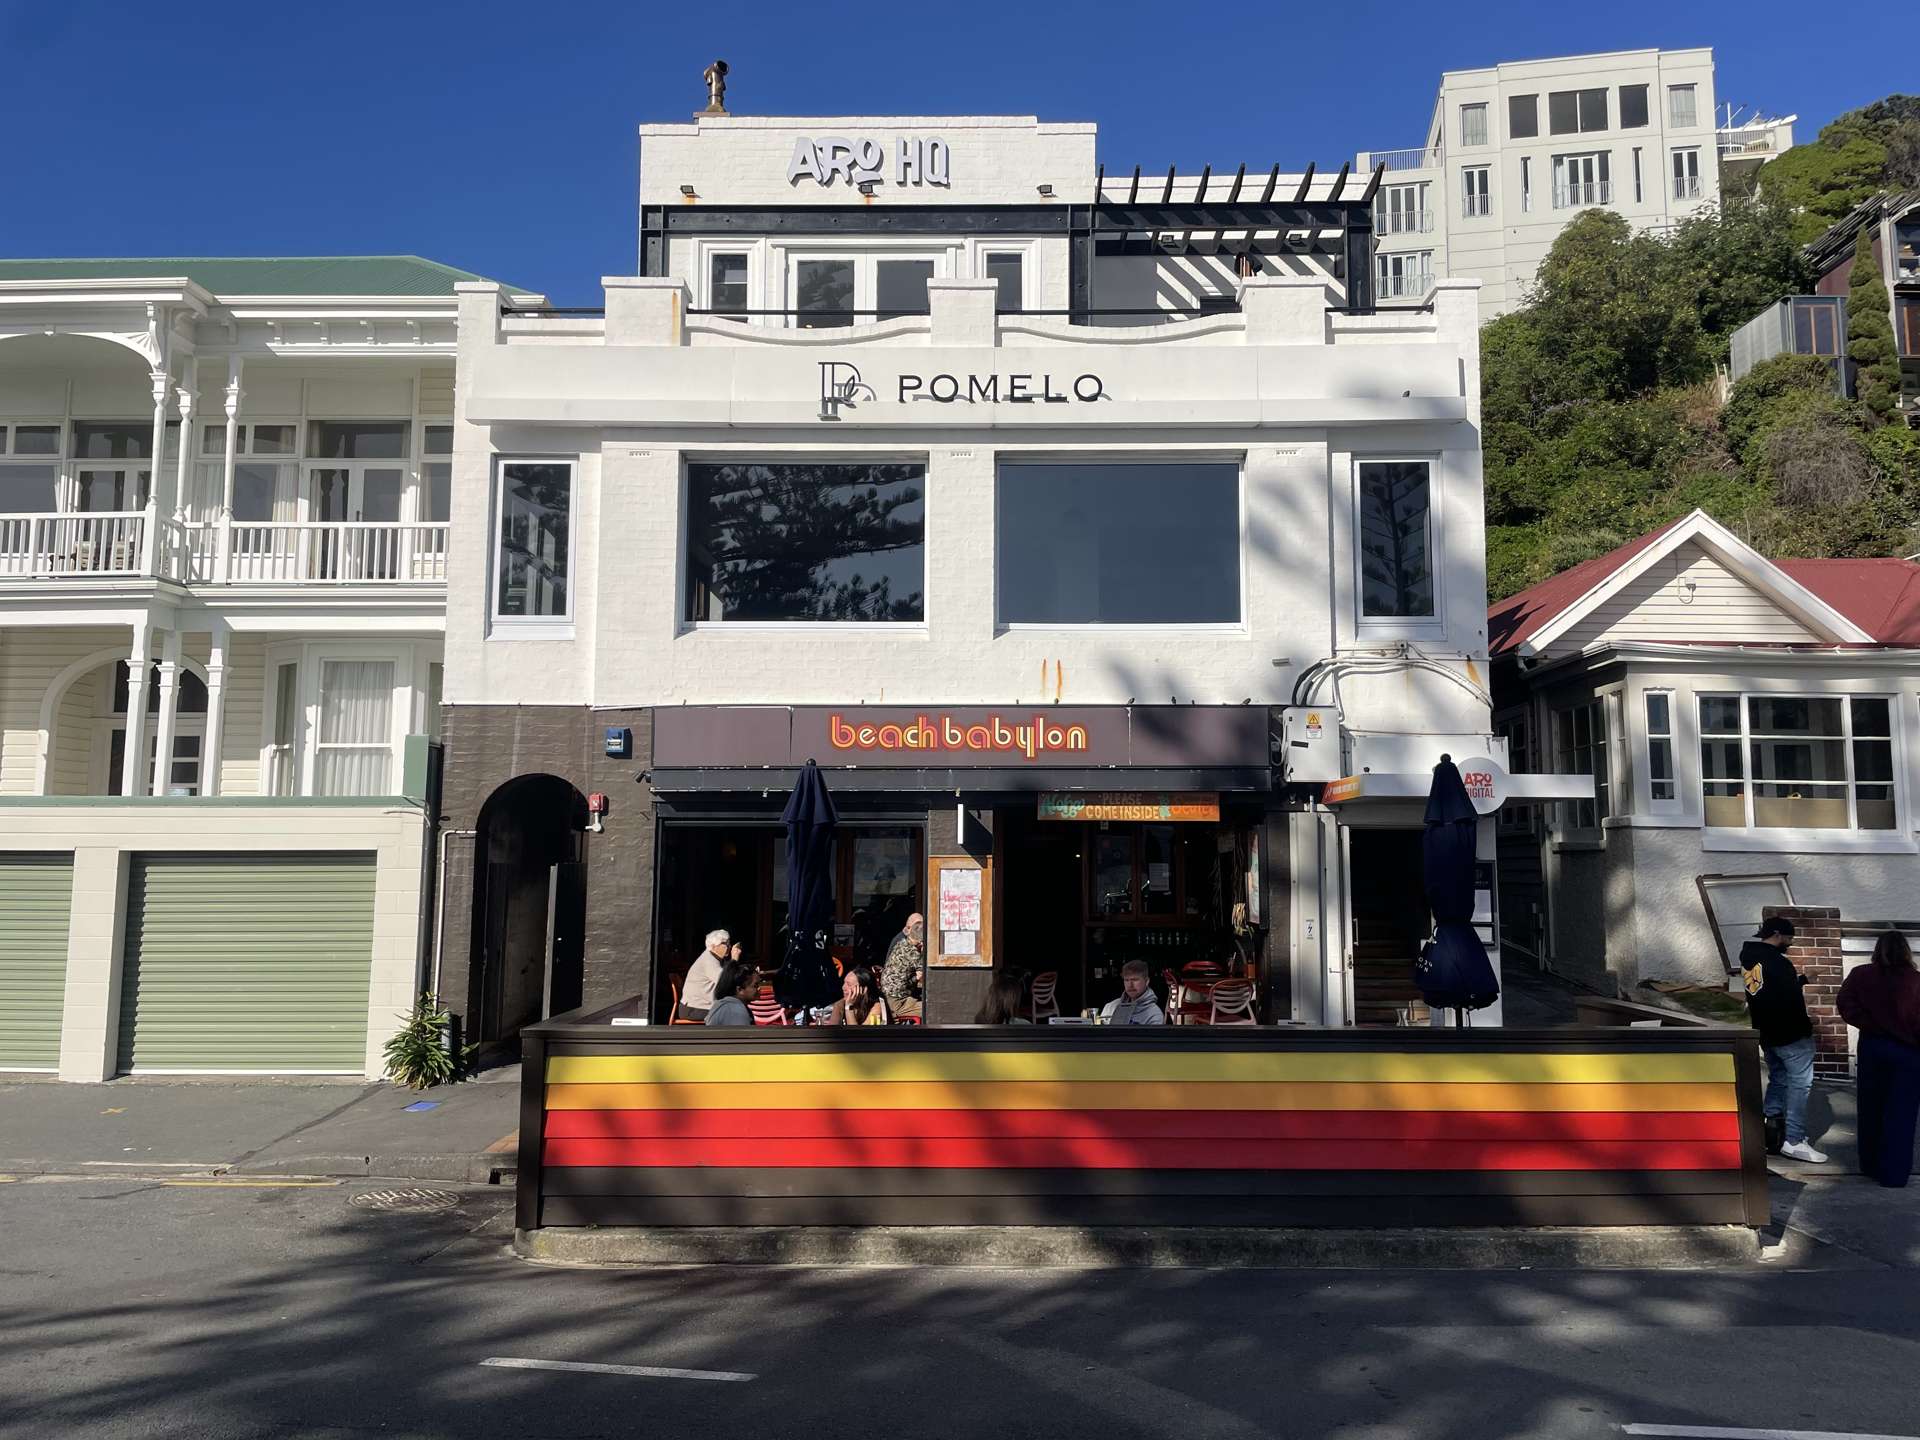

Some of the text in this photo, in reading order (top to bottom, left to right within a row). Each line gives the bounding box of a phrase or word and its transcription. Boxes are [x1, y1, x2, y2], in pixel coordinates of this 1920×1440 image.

[787, 136, 951, 189] ARO HQ
[898, 374, 1104, 404] POMELO
[829, 714, 1088, 760] beach babylon
